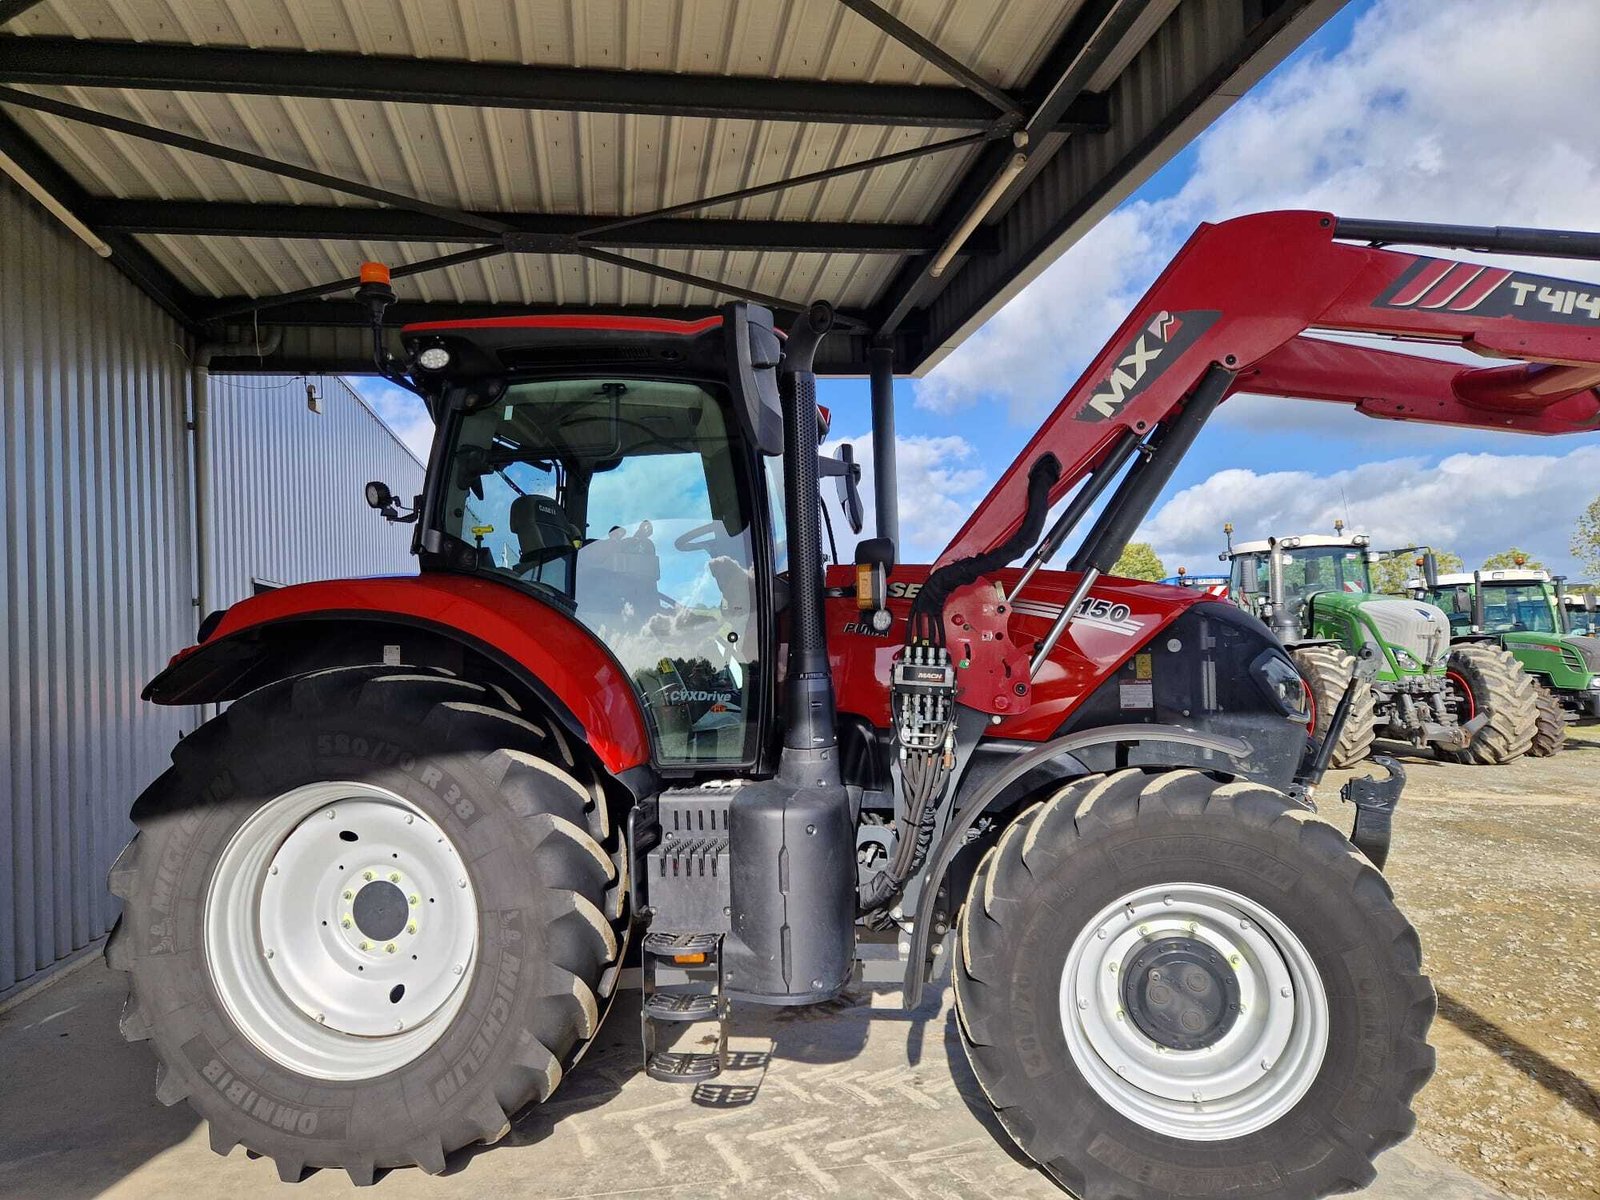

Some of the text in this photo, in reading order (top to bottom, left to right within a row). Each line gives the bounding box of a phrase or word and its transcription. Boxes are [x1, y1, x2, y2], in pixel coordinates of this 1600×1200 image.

[1511, 281, 1600, 319] T414
[1089, 334, 1163, 418] MX
[888, 582, 924, 599] SE
[1078, 597, 1131, 623] 150
[670, 690, 732, 702] CVXDrive
[917, 672, 943, 680] MACH
[317, 733, 476, 821] 580/70 R 38
[150, 768, 235, 916] MICHEIN
[433, 951, 522, 1107] MICHELIN
[202, 1058, 319, 1135] OMNIBIB
